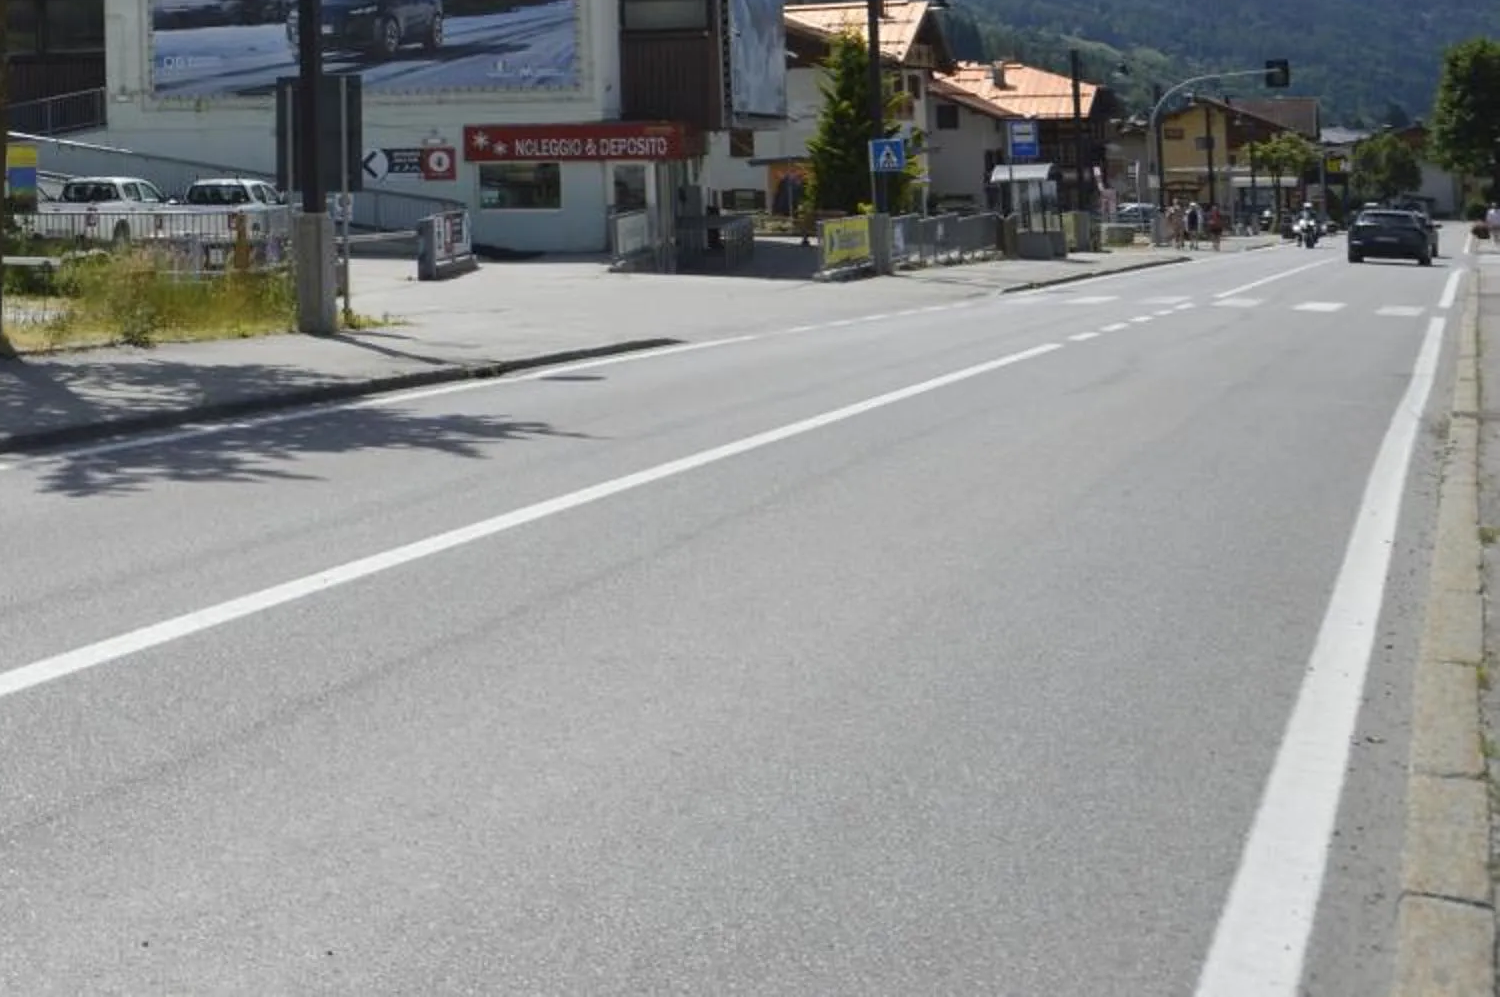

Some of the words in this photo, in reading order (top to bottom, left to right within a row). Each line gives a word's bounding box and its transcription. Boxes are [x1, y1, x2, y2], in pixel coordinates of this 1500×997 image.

[515, 138, 581, 156] NOLEGGIO
[585, 138, 597, 156] &
[599, 136, 668, 156] DEPOSITO
